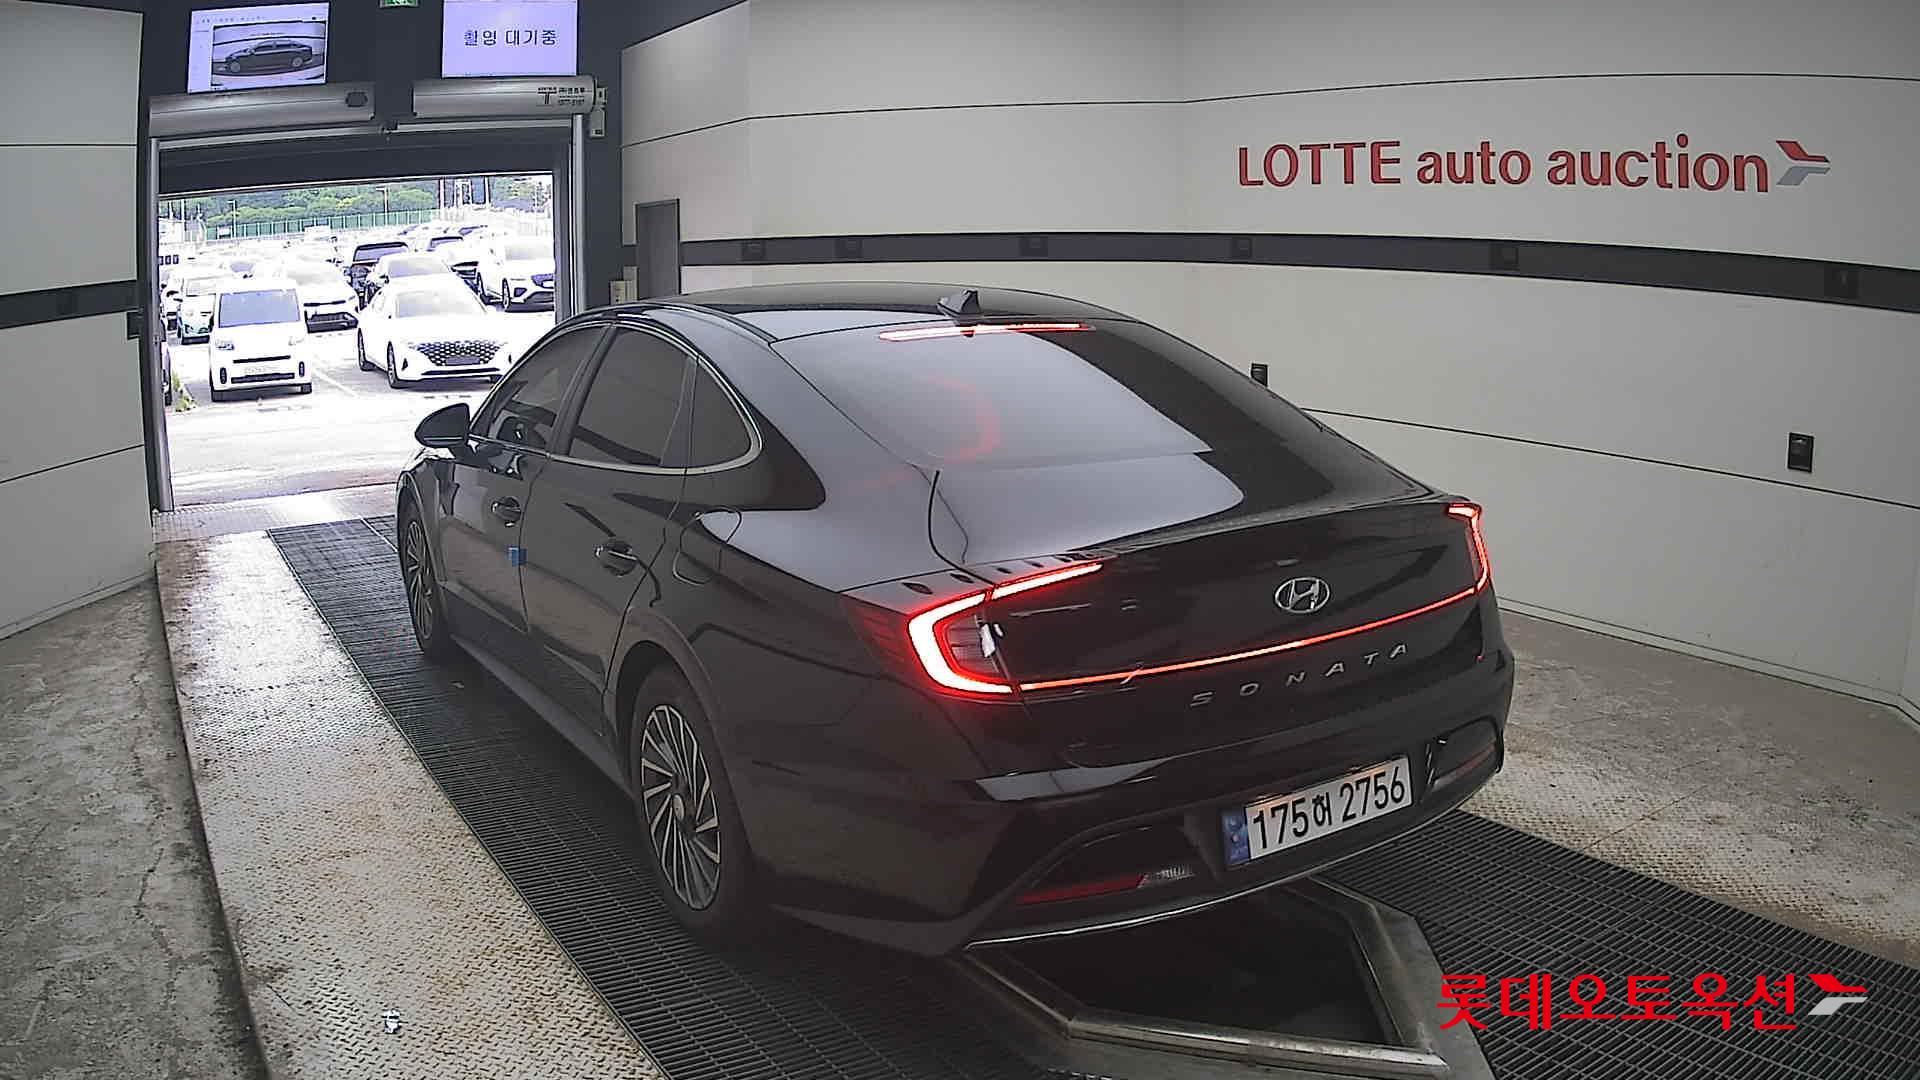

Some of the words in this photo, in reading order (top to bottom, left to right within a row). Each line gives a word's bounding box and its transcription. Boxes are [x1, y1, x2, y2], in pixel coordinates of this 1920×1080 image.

[504, 29, 558, 46] 대기중
[1239, 141, 1400, 187] LOTTE
[1416, 140, 1532, 186] auto
[1546, 133, 1770, 193] auction
[1190, 643, 1408, 707] SONATA
[1339, 766, 1406, 823] 2756
